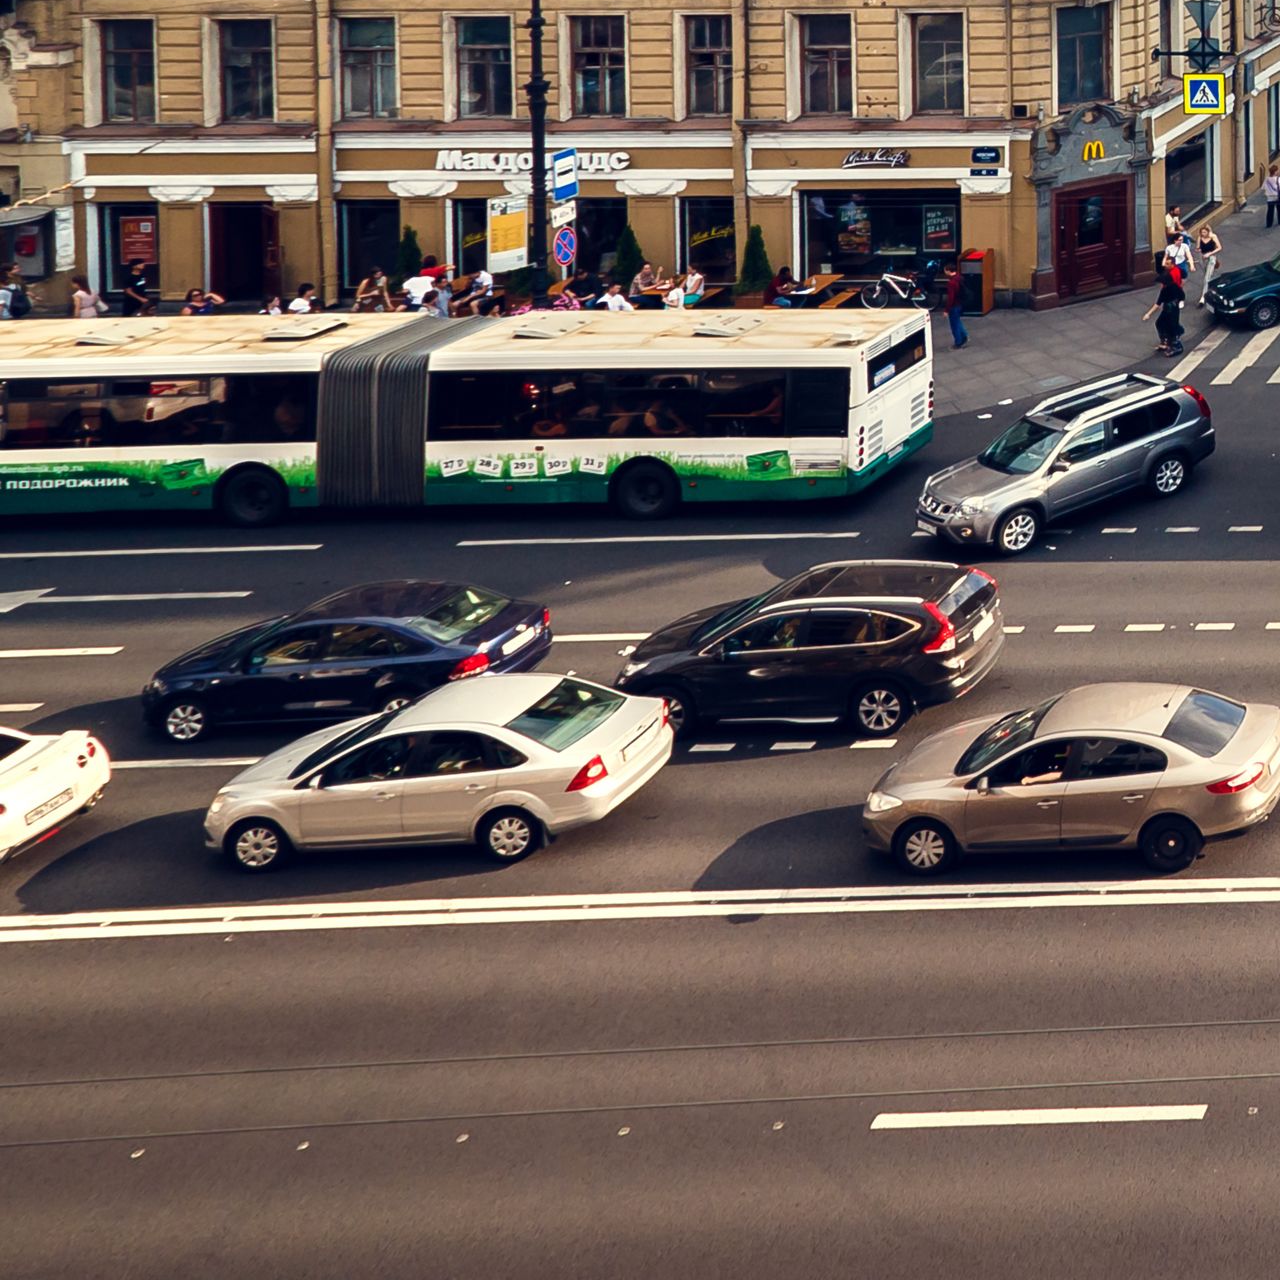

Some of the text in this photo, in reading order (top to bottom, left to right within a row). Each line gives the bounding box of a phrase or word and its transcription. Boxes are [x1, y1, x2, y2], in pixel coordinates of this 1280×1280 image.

[435, 150, 630, 173] Макдолдс
[479, 459, 491, 467] 28
[547, 460, 560, 469] 30
[583, 458, 594, 466] 31
[6, 477, 129, 490] ПОДОРОЖНИК
